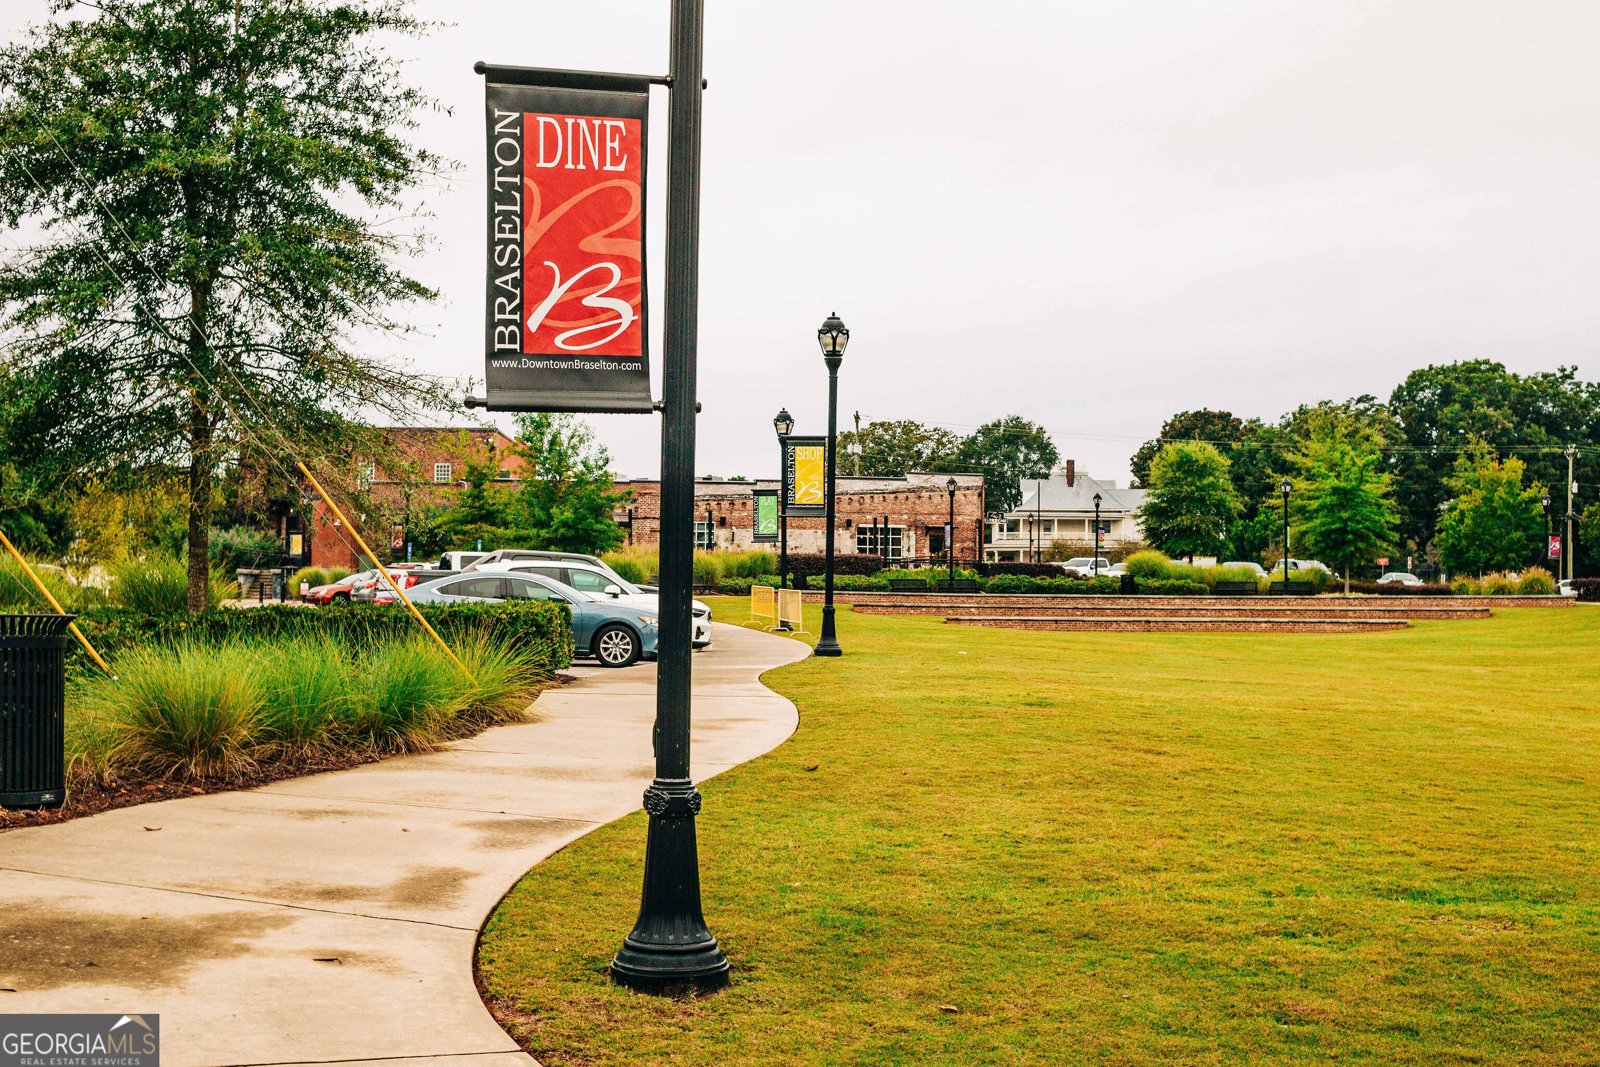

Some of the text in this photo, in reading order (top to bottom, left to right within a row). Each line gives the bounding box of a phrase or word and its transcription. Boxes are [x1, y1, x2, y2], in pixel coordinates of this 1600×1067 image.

[535, 115, 628, 171] DINE
[494, 108, 521, 352] BRASELTON
[491, 358, 642, 371] www.DowntownBraselton.com
[787, 445, 795, 504] BRASELTON
[796, 446, 823, 460] SHOP
